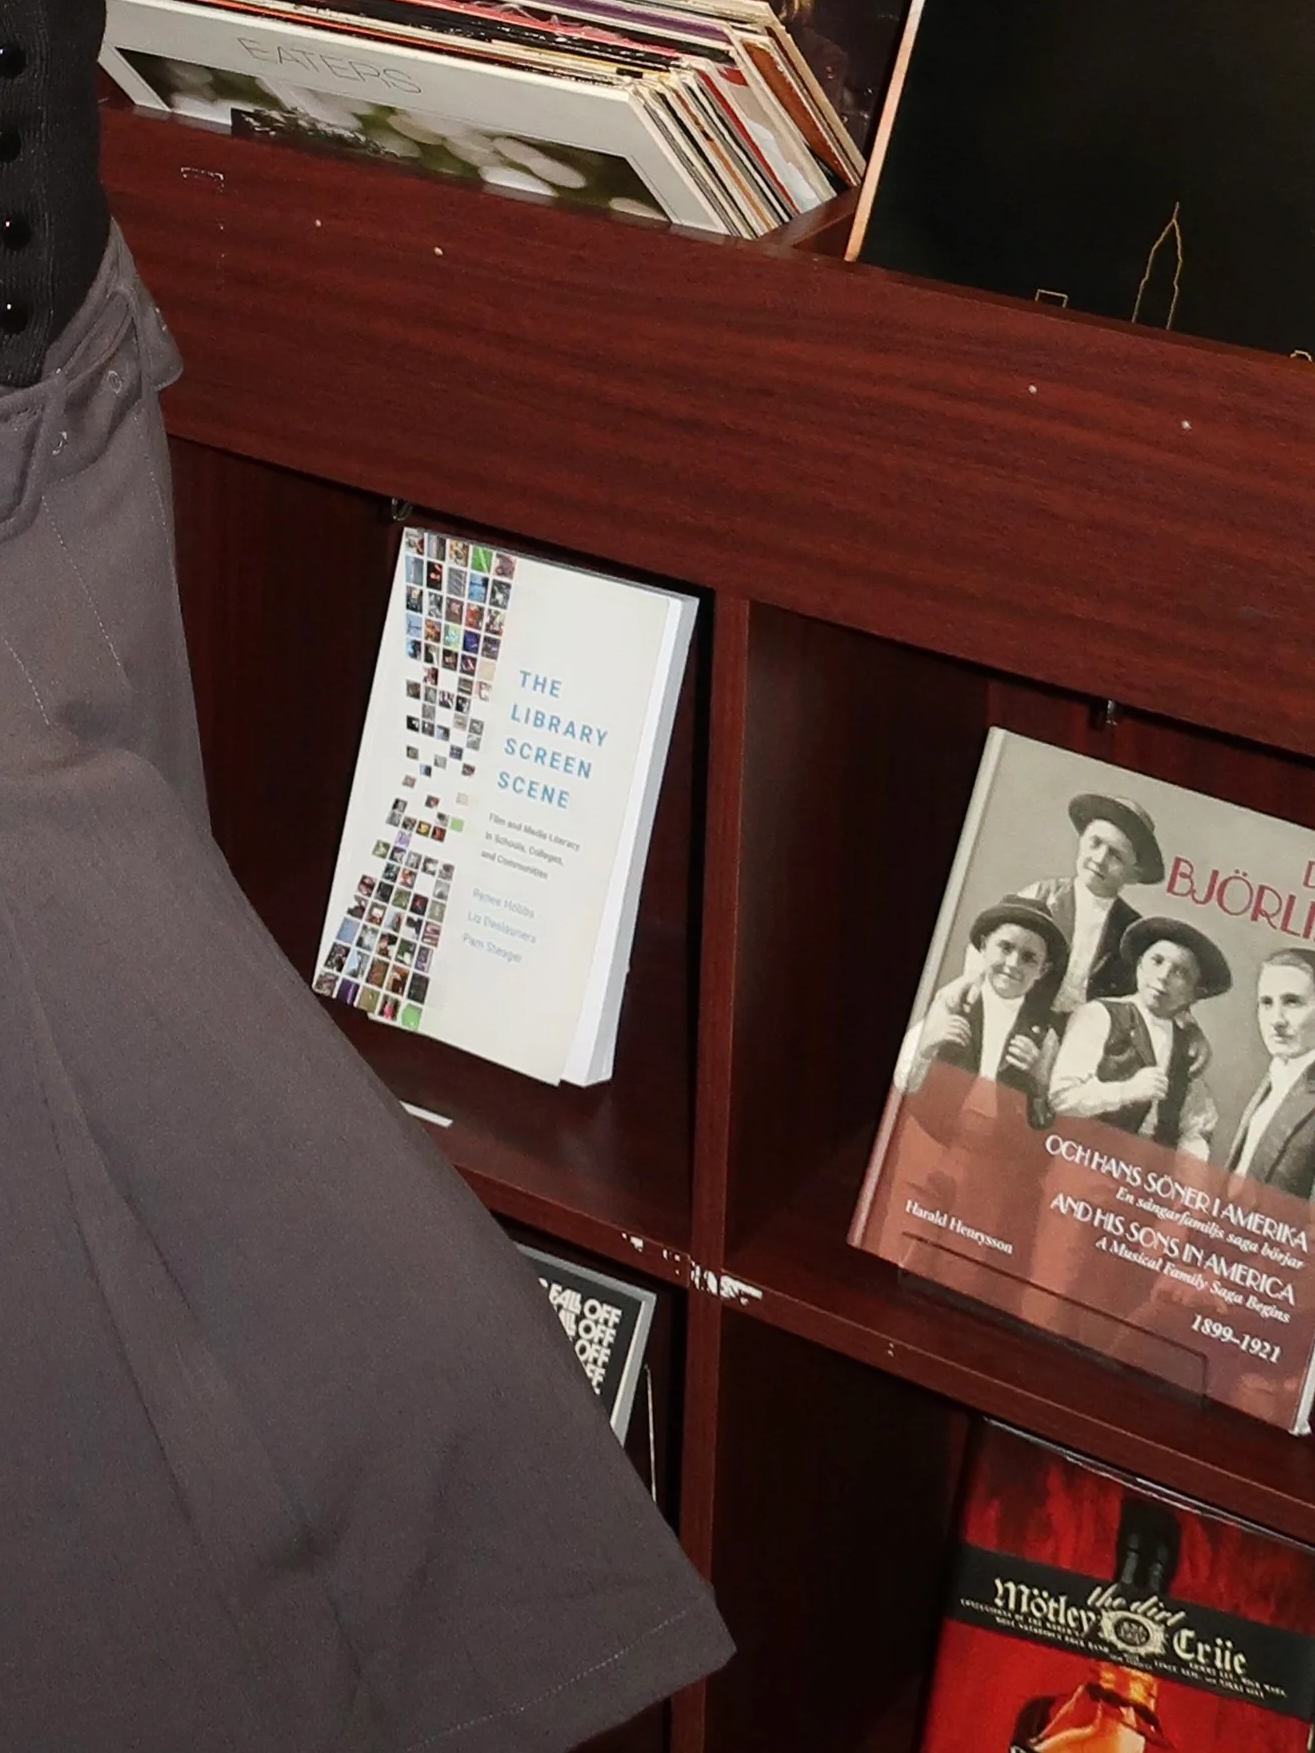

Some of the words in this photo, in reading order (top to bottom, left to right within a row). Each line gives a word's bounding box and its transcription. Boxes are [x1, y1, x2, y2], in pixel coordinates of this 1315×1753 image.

[237, 37, 422, 94] EATERS
[519, 670, 563, 698] THE
[510, 703, 609, 747] LIBRARY
[504, 737, 593, 779] SCREEN
[497, 770, 570, 809] SCENE
[507, 818, 522, 832] and
[523, 821, 548, 840] Media
[1045, 1134, 1092, 1169] OCH
[1093, 1150, 1142, 1188] HANS
[1145, 1167, 1211, 1214] SÖNER
[1223, 1196, 1309, 1253] AMERIKA
[905, 1201, 948, 1232] Harald
[948, 1213, 1014, 1255] Henrysson
[1050, 1193, 1094, 1227] AND
[1095, 1211, 1124, 1239] HIS
[1126, 1221, 1180, 1264] SONS
[1181, 1243, 1206, 1271] IN
[1205, 1250, 1297, 1306] AMERICA
[1115, 1185, 1136, 1206] En
[1225, 1226, 1258, 1255] saga
[1259, 1234, 1306, 1271] börjar
[1095, 1235, 1109, 1250] A
[1110, 1240, 1160, 1274] Musical
[1160, 1258, 1209, 1294] Family
[1210, 1274, 1247, 1307] Saga
[1247, 1288, 1291, 1324] Begins
[578, 1318, 617, 1348] OFF
[583, 1298, 623, 1328] OFF
[994, 1577, 1097, 1635] Mötley
[1172, 1627, 1247, 1675] Crüe
[1087, 1583, 1127, 1610] the
[1130, 1596, 1186, 1627] dirt
